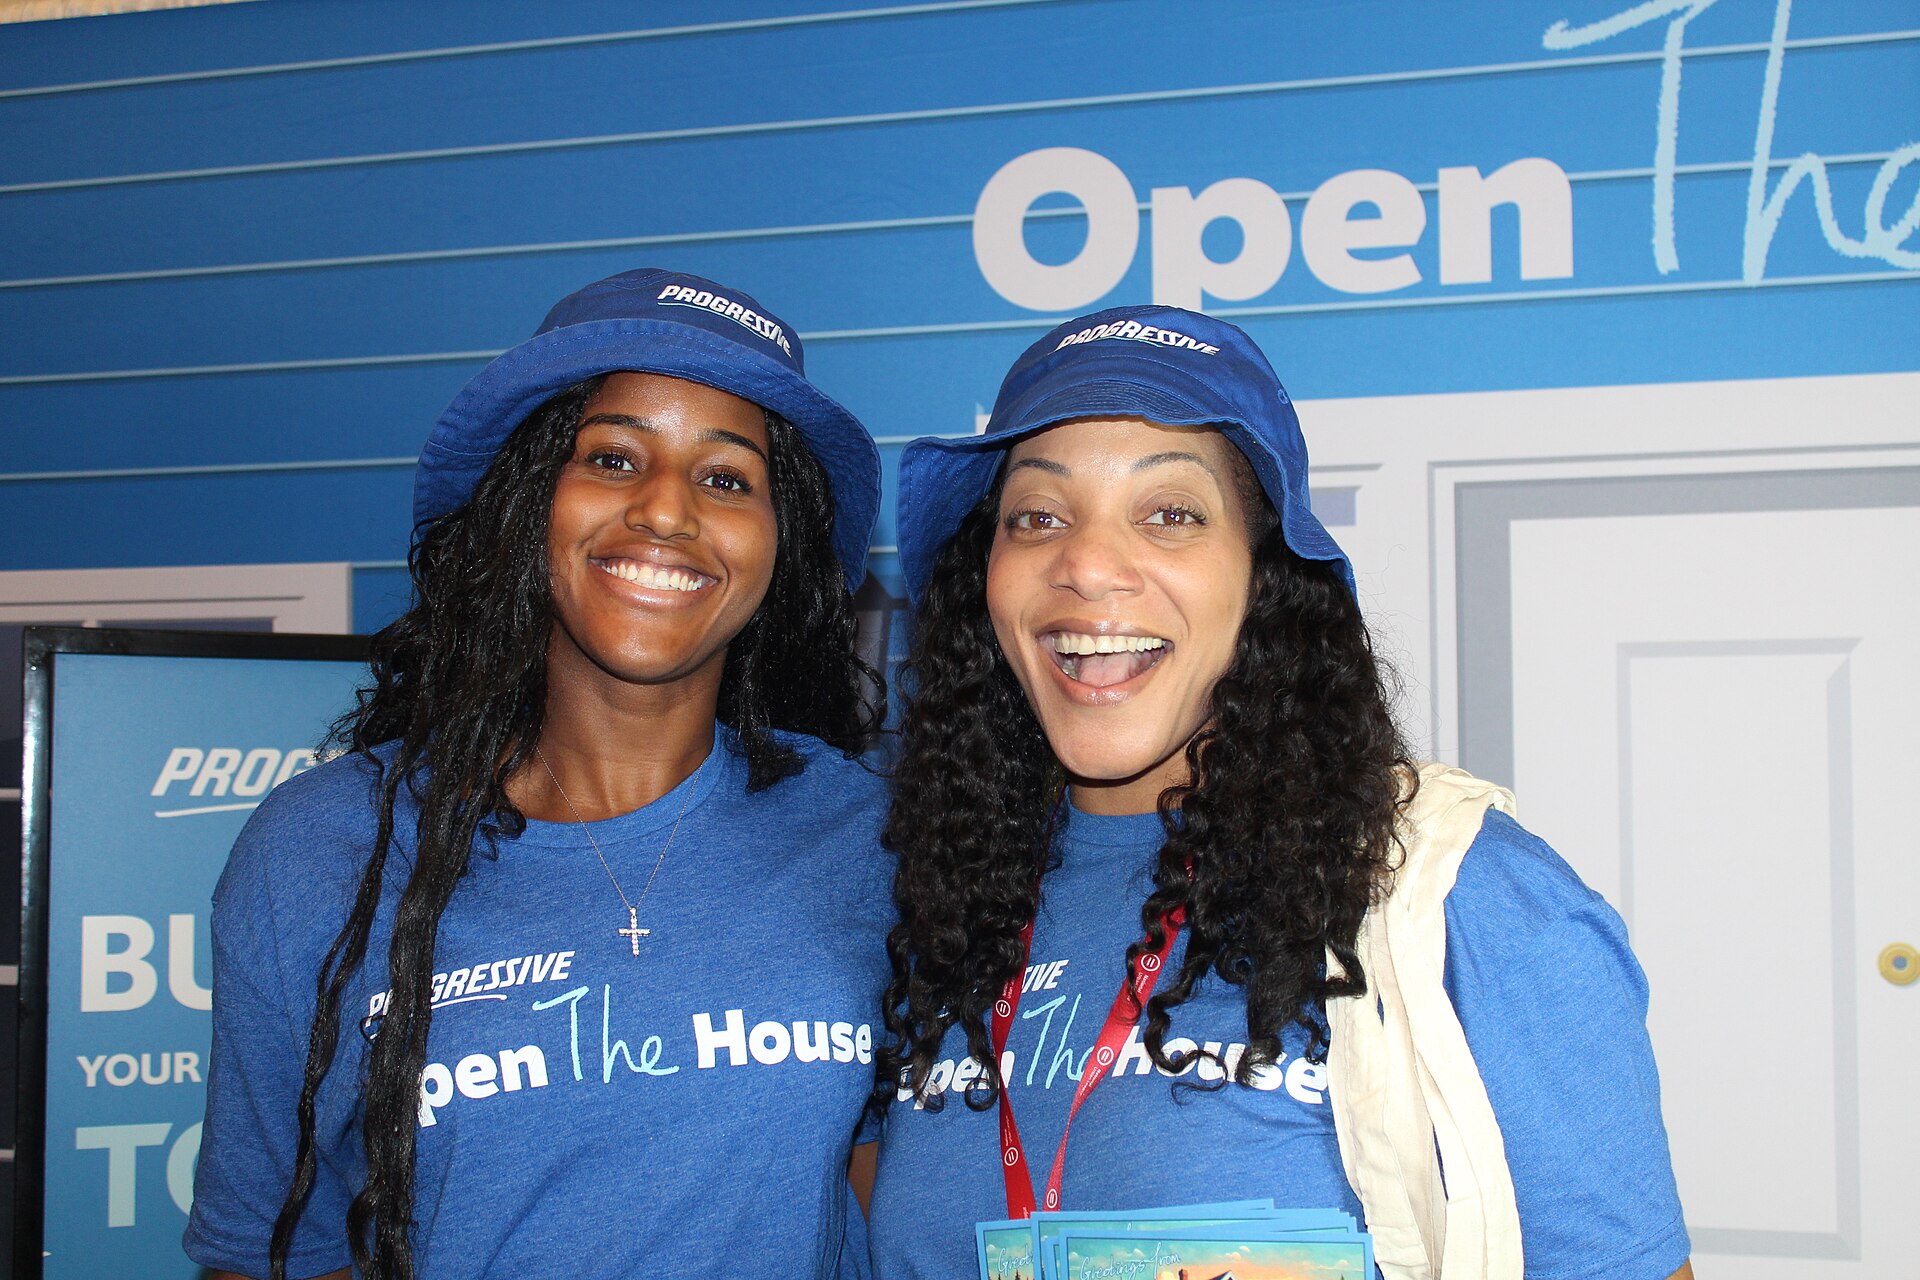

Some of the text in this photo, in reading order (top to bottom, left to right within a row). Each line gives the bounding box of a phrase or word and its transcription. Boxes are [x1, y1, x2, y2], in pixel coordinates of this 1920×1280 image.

[972, 146, 1574, 312] Open
[657, 284, 792, 358] PROGRESSIVE
[1053, 320, 1221, 356] PROGRESSIVE
[365, 950, 576, 1028] PGRESSIVE
[76, 1051, 202, 1088] YOUR
[417, 984, 872, 1129] pen The House
